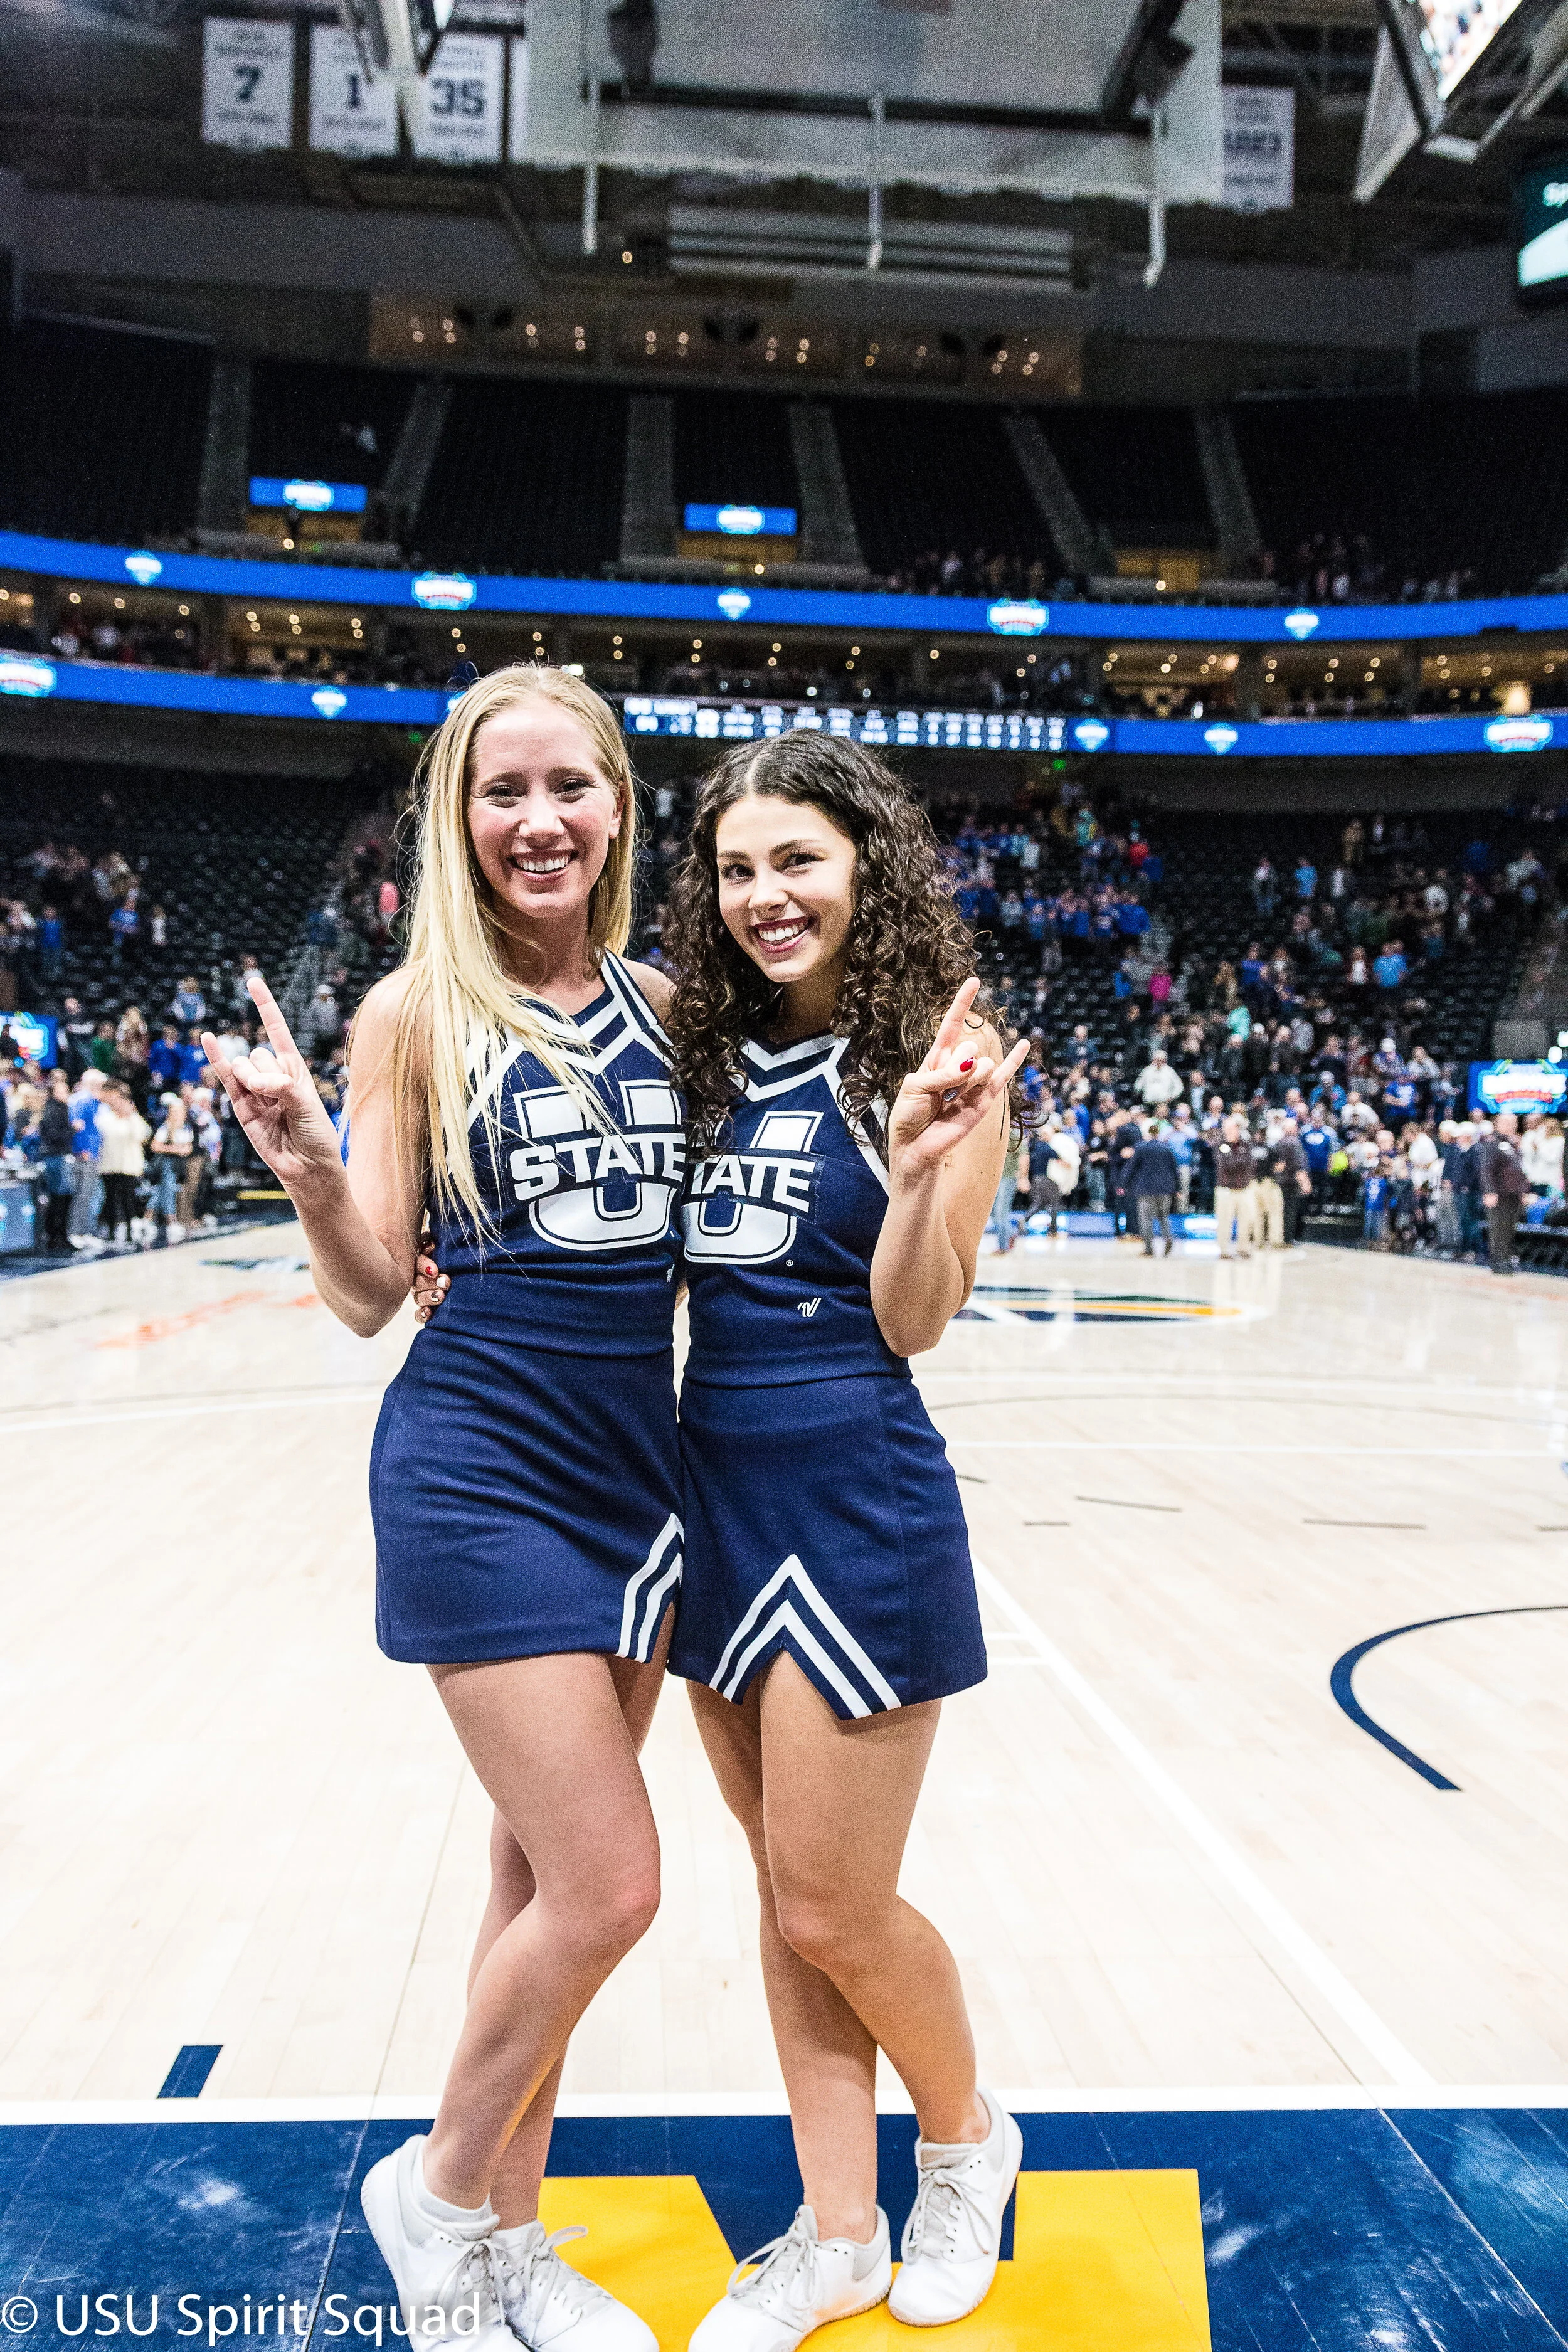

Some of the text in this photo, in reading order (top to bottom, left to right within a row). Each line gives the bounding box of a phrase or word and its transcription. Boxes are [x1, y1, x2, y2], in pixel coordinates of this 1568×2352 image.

[235, 65, 262, 102] 7
[347, 73, 361, 109] 1
[431, 78, 486, 117] 35
[509, 1133, 687, 1202] STATE
[691, 1155, 816, 1213] TATE
